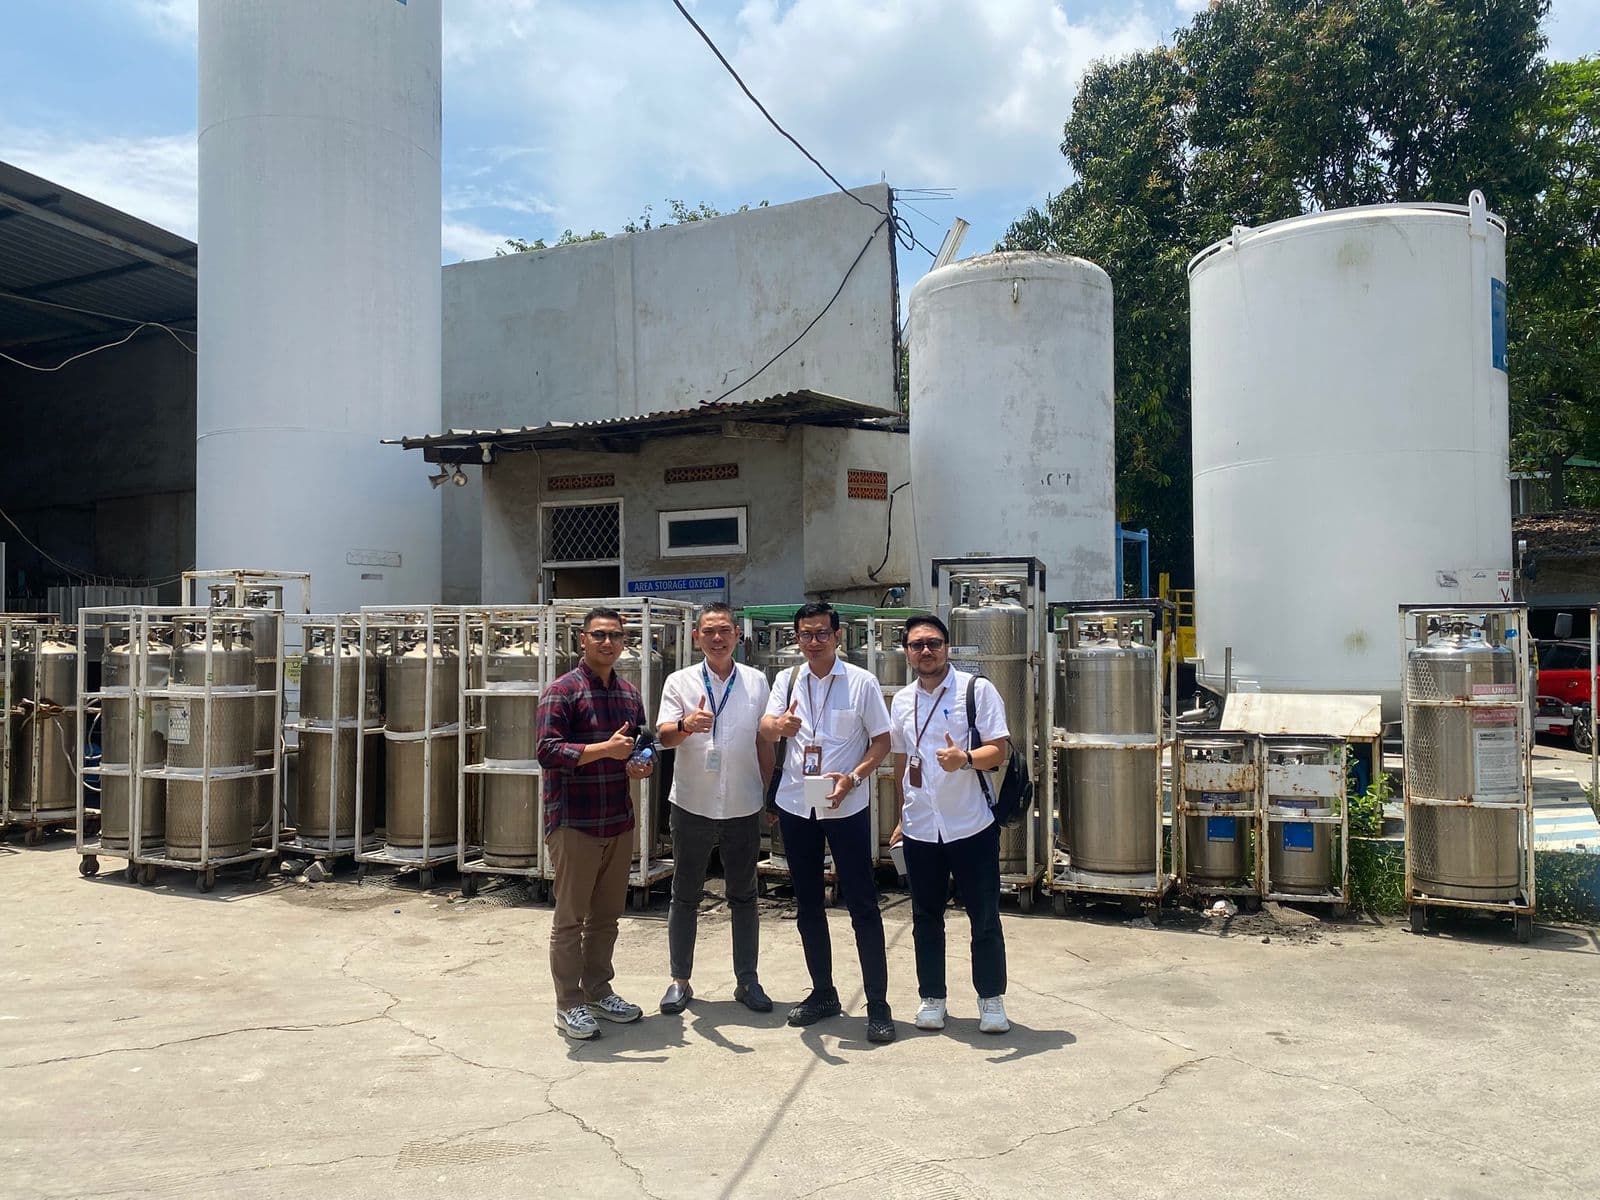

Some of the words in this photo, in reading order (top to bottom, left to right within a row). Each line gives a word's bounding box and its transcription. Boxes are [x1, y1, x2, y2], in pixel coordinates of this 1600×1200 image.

[634, 582, 654, 592] AREA
[655, 580, 687, 590] STORAGE
[689, 579, 719, 589] OXYGEN
